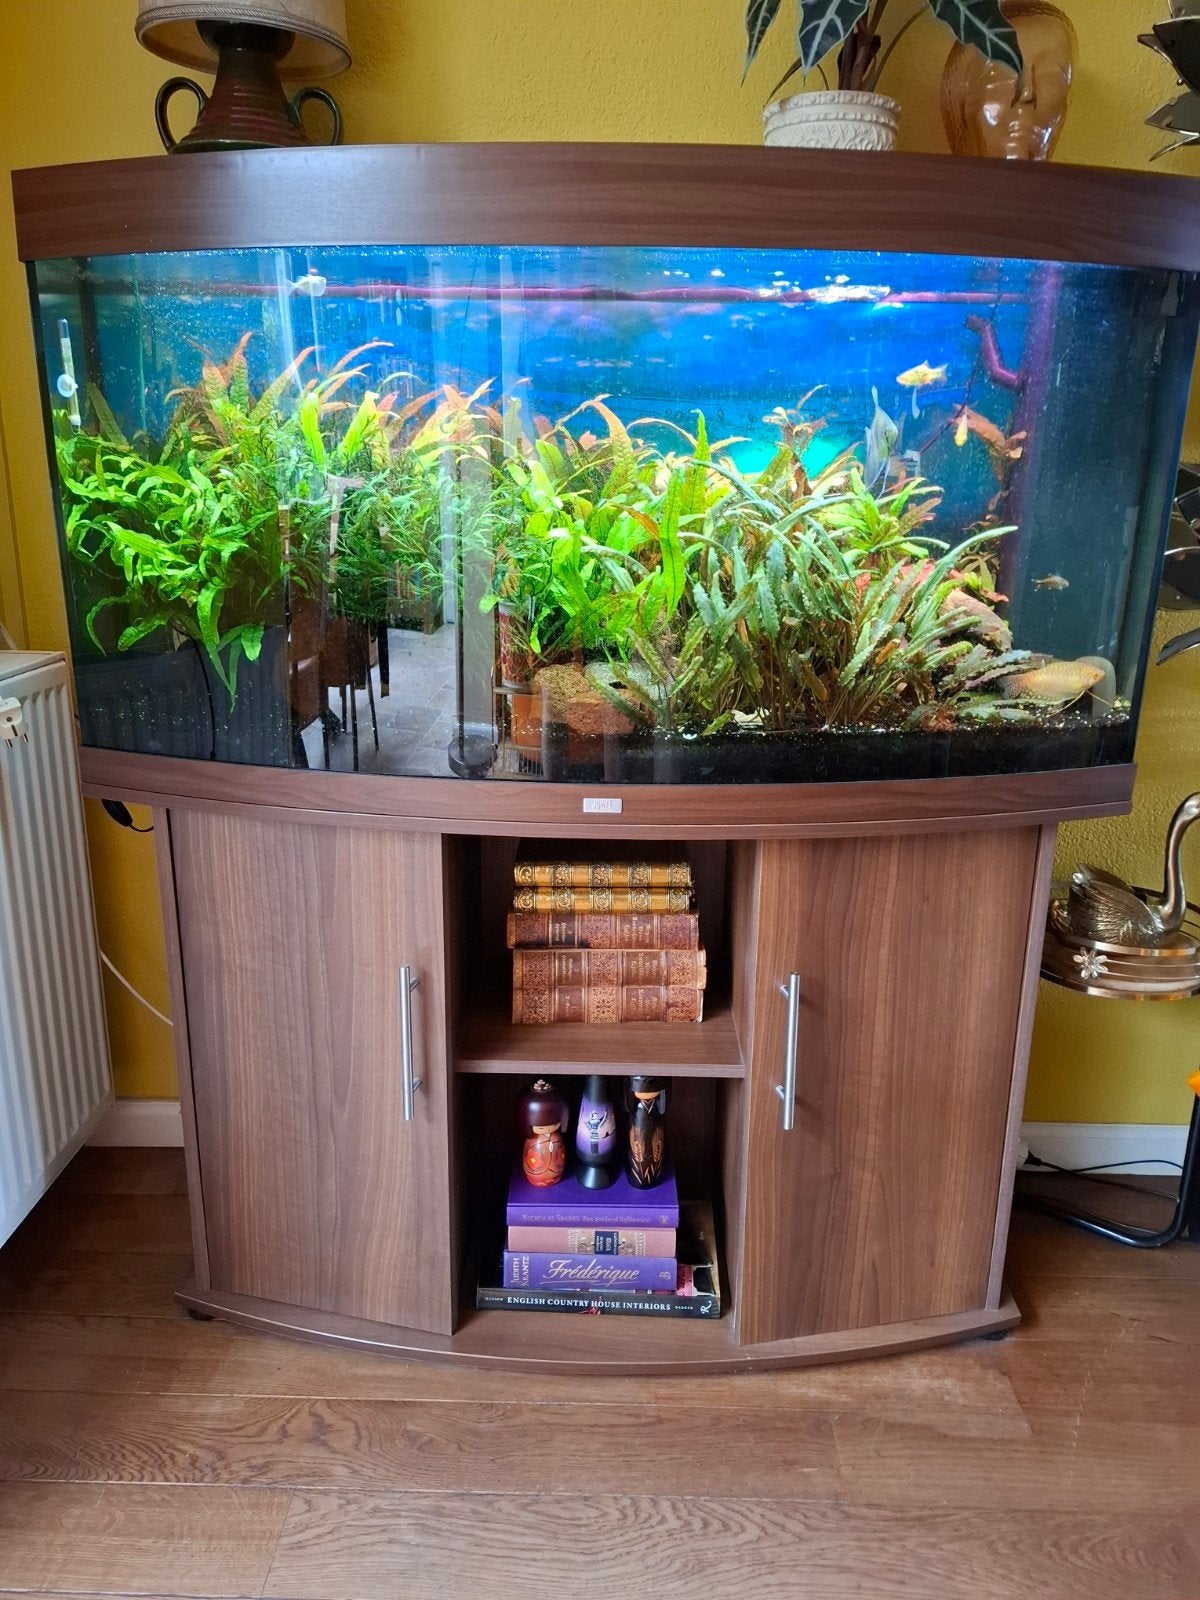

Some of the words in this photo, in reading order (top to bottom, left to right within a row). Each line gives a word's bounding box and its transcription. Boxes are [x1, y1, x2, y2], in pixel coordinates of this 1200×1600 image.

[511, 1258, 519, 1285] JUDITH
[520, 1256, 530, 1286] KRANTZ
[543, 1258, 640, 1287] Frédérique
[507, 1296, 545, 1305] ENGLISH
[547, 1298, 589, 1307] COUNTRY
[591, 1300, 621, 1308] HOUSE
[622, 1301, 671, 1311] INTERIORS
